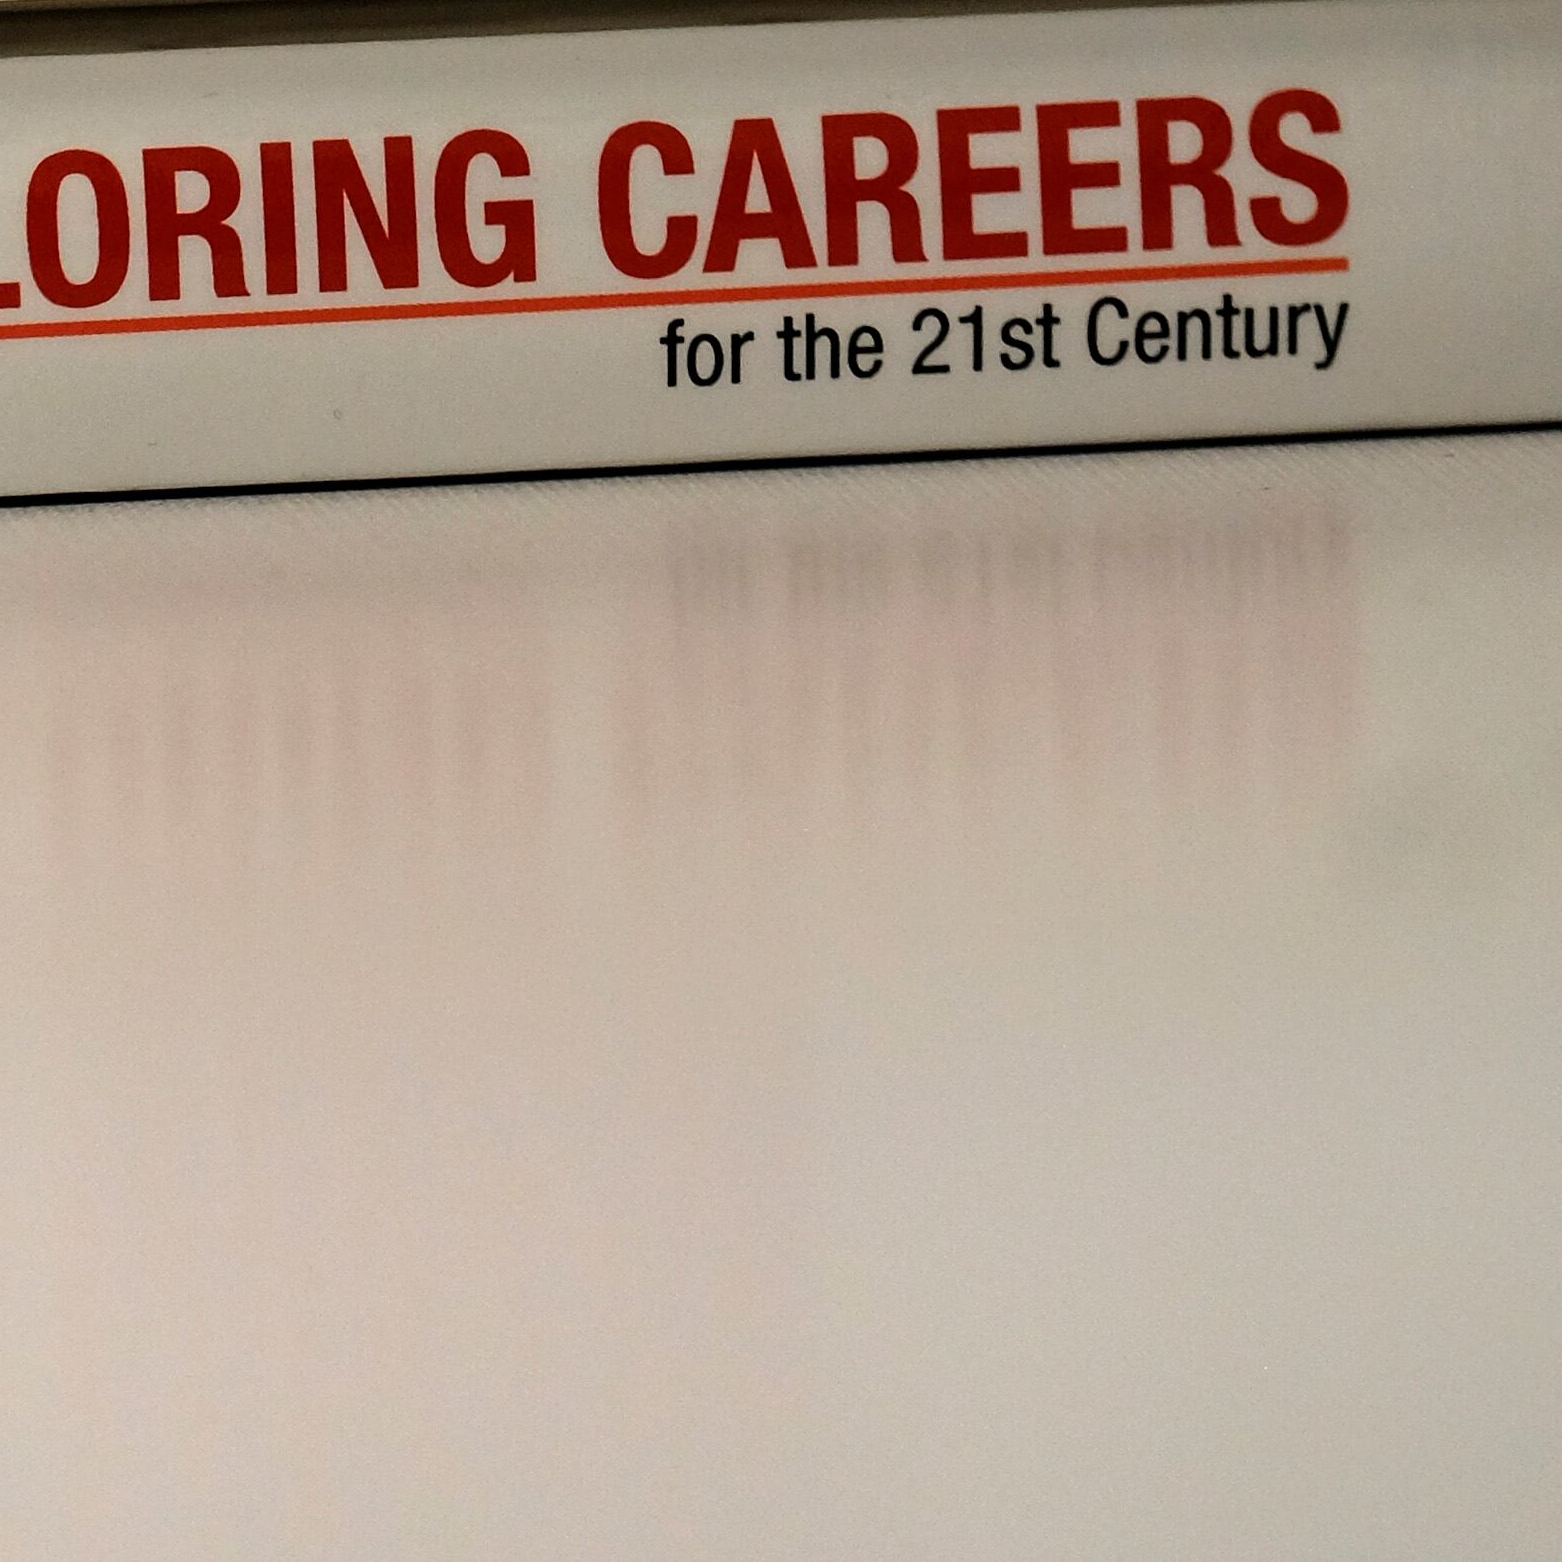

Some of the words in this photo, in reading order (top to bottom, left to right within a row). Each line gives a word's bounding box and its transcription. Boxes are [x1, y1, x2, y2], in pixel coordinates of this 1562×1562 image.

[598, 89, 1349, 280] CAREERS
[659, 317, 756, 388] for
[775, 312, 885, 383] the
[910, 301, 1062, 376] 21st
[1086, 292, 1351, 372] Century
